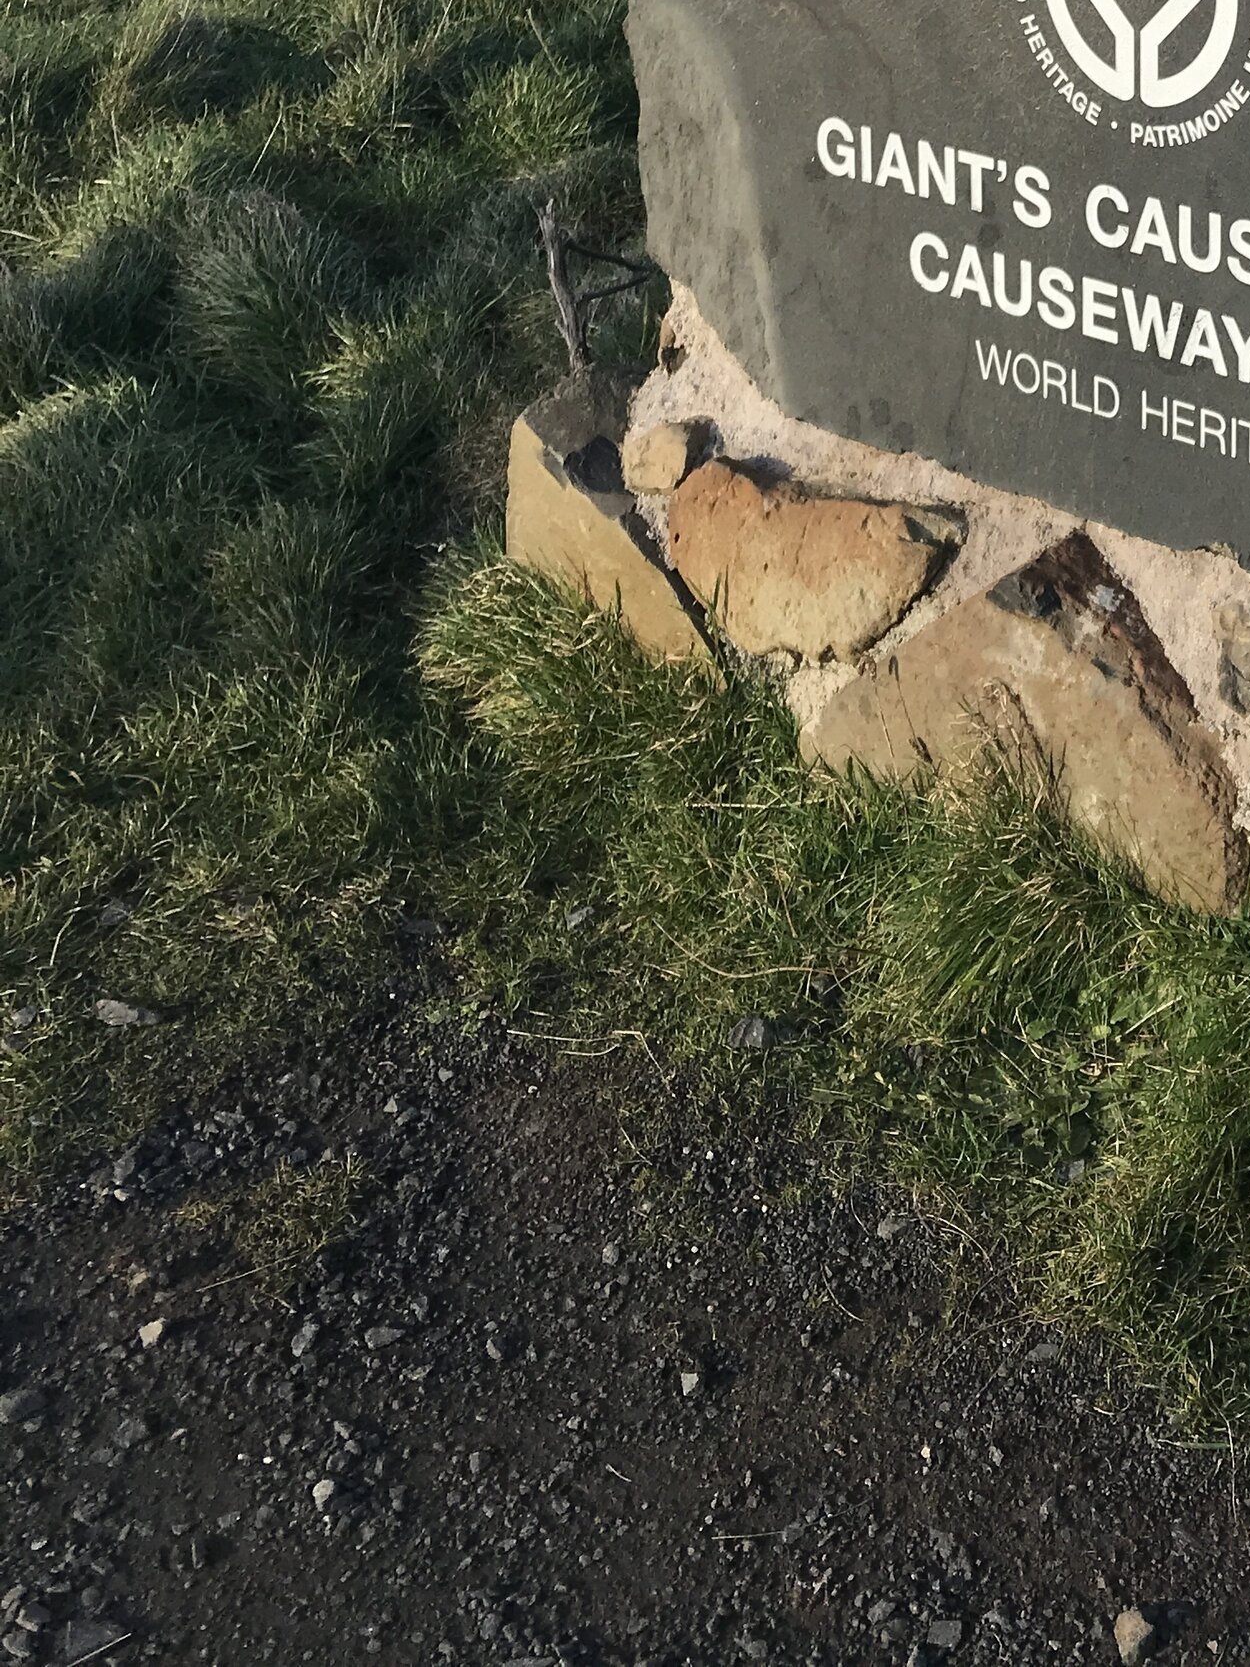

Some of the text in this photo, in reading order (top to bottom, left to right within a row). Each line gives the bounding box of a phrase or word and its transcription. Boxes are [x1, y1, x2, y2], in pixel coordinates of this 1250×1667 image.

[1019, 14, 1102, 126] HERITAGE
[1130, 79, 1250, 148] PATRIMOINE
[815, 115, 1052, 229] GIANT'S
[975, 339, 1121, 420] WORLD
